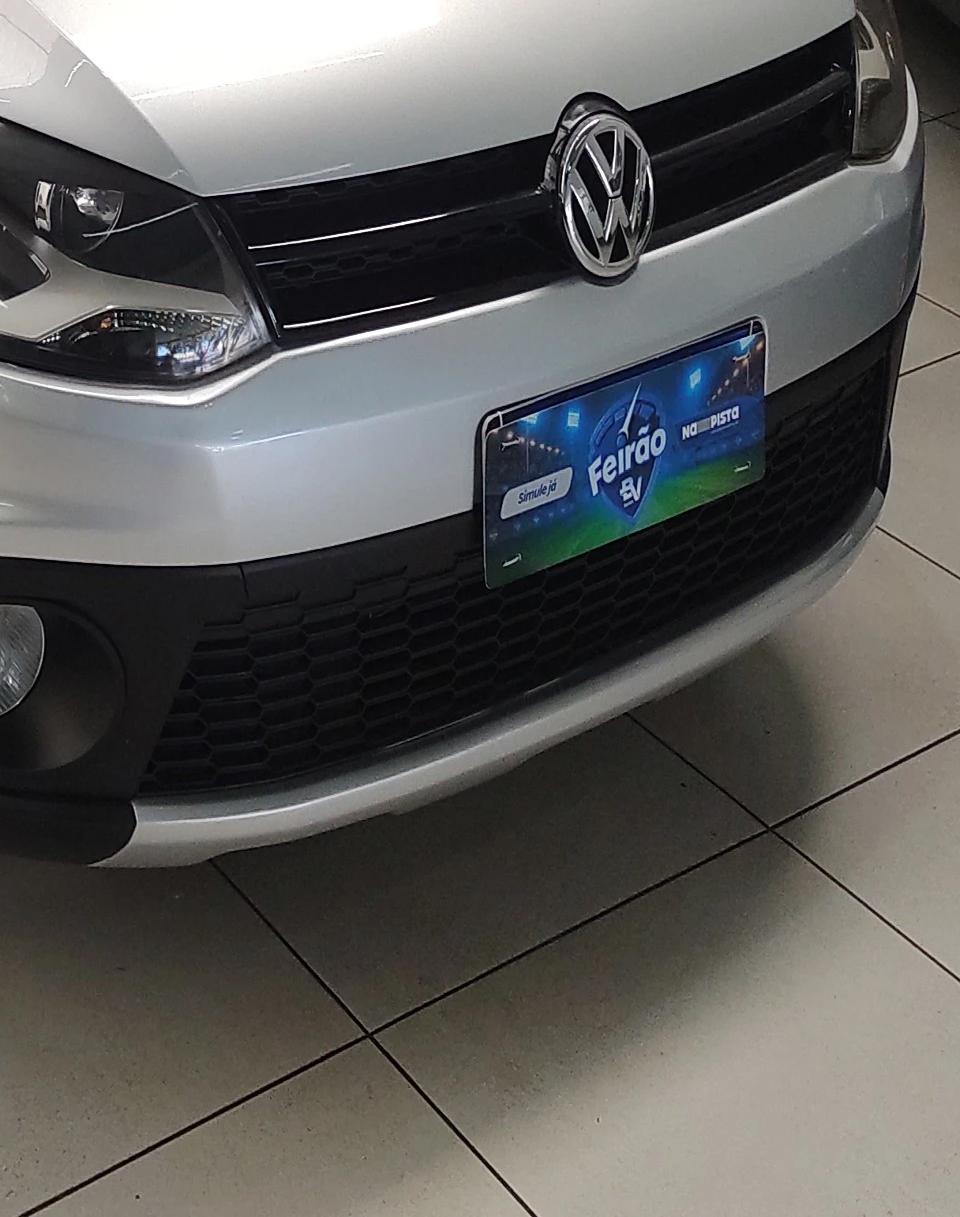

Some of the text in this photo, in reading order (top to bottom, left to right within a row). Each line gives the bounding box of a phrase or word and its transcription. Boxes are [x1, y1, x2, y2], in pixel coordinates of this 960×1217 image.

[588, 424, 666, 497] Feirão
[518, 479, 557, 505] Simule já
